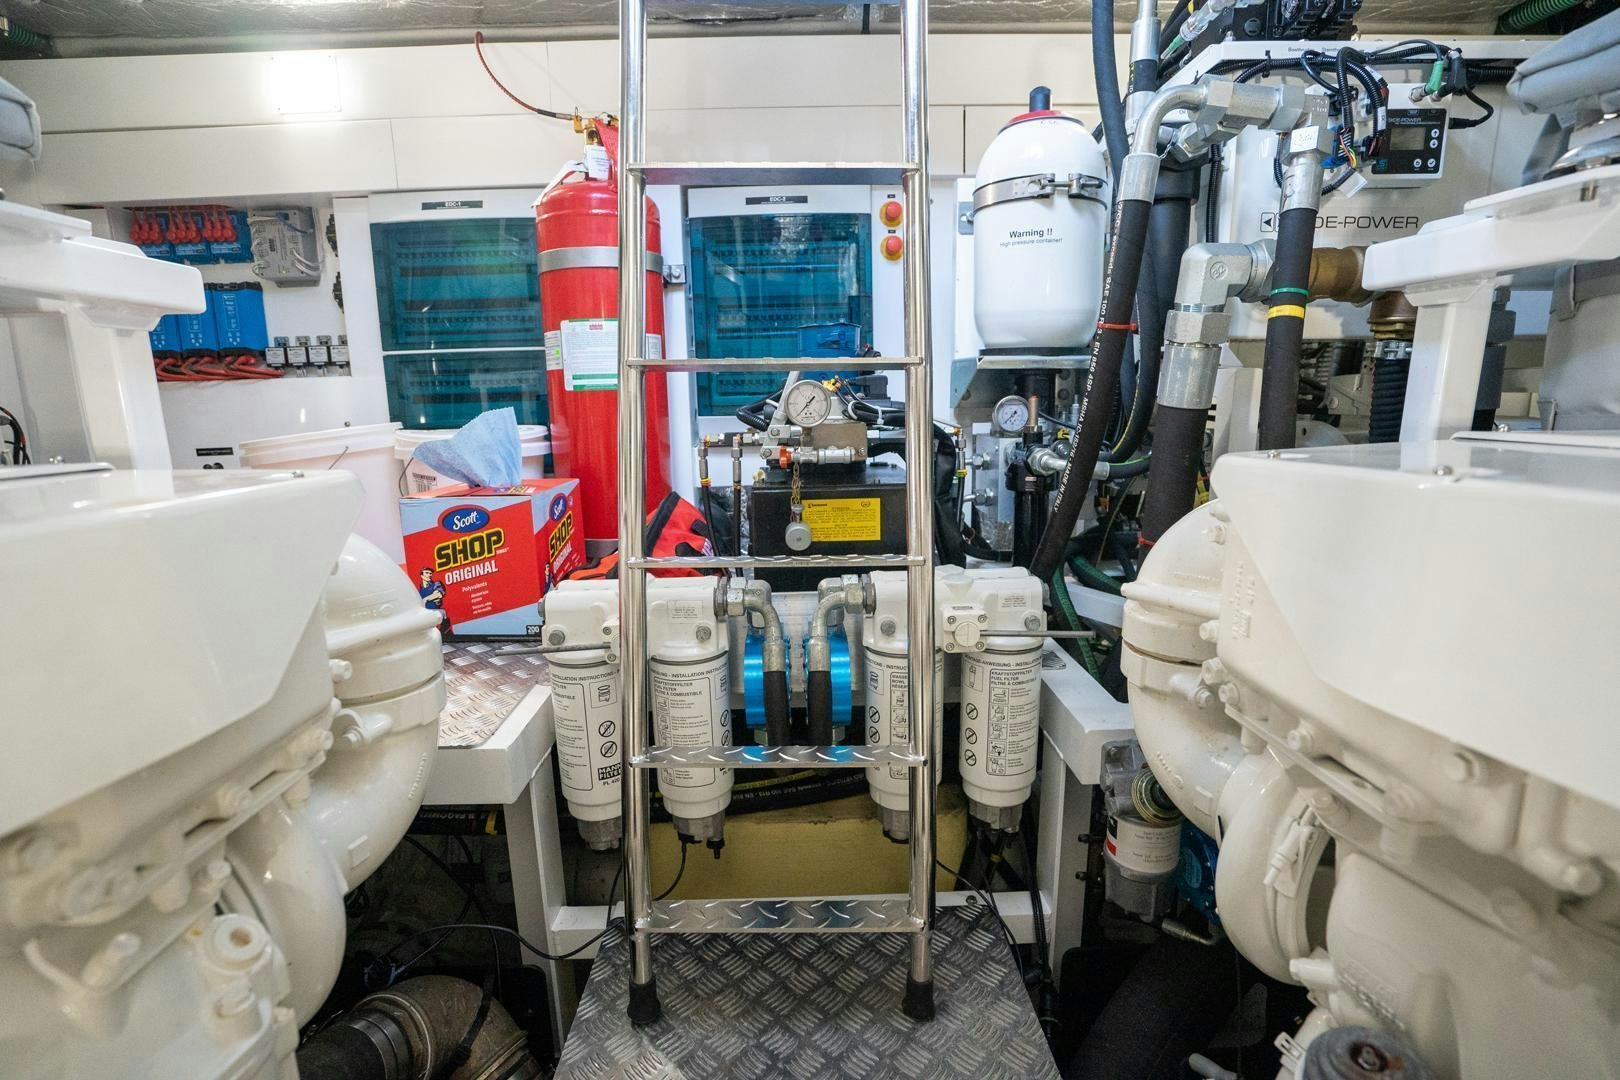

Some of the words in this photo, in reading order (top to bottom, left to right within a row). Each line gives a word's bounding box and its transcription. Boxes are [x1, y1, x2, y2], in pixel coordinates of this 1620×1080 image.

[1315, 216, 1419, 229] DE-POWER
[1009, 229, 1044, 238] Warning
[1047, 228, 1053, 236] !!
[1104, 276, 1112, 297] SAE
[1097, 317, 1105, 334] R3
[1092, 341, 1100, 356] EN
[1085, 374, 1094, 392] 4SP
[1079, 397, 1089, 423] MSHA
[1062, 463, 1073, 486] MADE
[1059, 484, 1067, 495] IN
[553, 498, 564, 519] Scott
[1053, 494, 1063, 513] ITALY
[453, 510, 479, 530] Scott
[549, 511, 573, 563] SHOP
[435, 528, 504, 571] SHOP
[445, 560, 499, 585] ORIGINAL
[527, 626, 540, 634] 200
[672, 670, 704, 678] INSTALLATION
